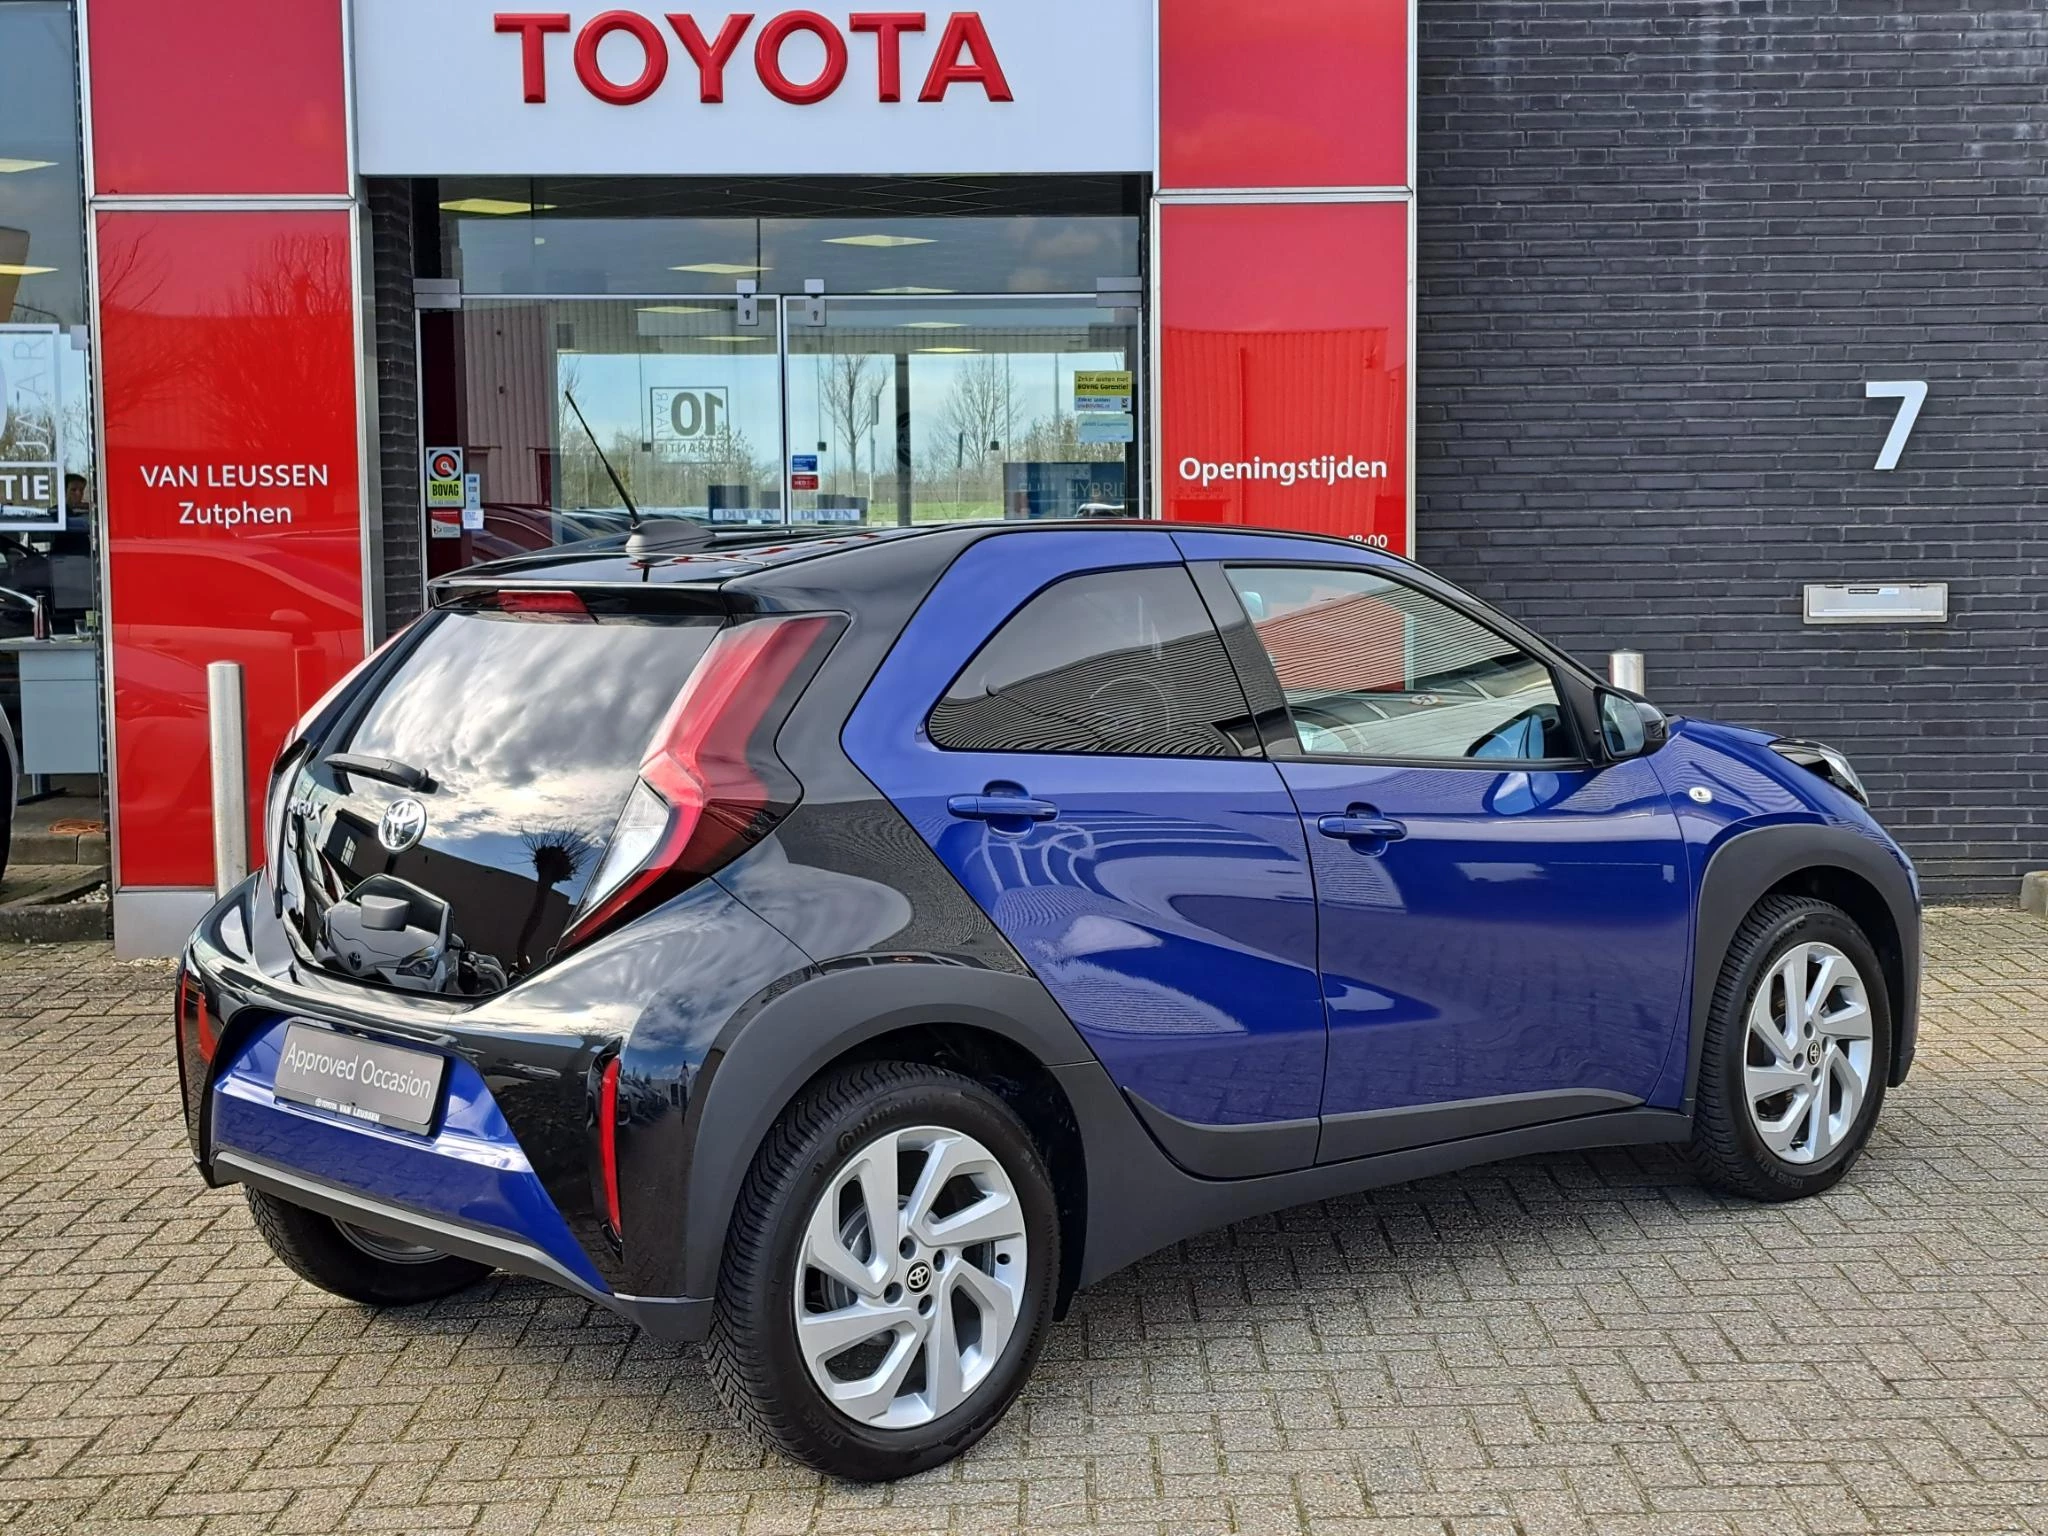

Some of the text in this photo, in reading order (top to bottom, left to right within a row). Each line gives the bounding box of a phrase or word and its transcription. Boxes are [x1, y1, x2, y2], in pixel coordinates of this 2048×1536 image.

[494, 9, 1014, 106] TOYOTA
[1865, 380, 1929, 471] 7
[140, 464, 329, 487] VAN LEUSSEN
[1179, 455, 1388, 487] Openingstijden
[432, 483, 459, 497] BOVAG
[178, 501, 293, 529] Zutphen
[721, 510, 774, 520] DUWEN
[800, 510, 852, 521] DUWEN
[284, 1042, 432, 1100] Approved Occasion
[339, 1104, 352, 1114] VAN
[353, 1107, 380, 1122] LEUSSEN
